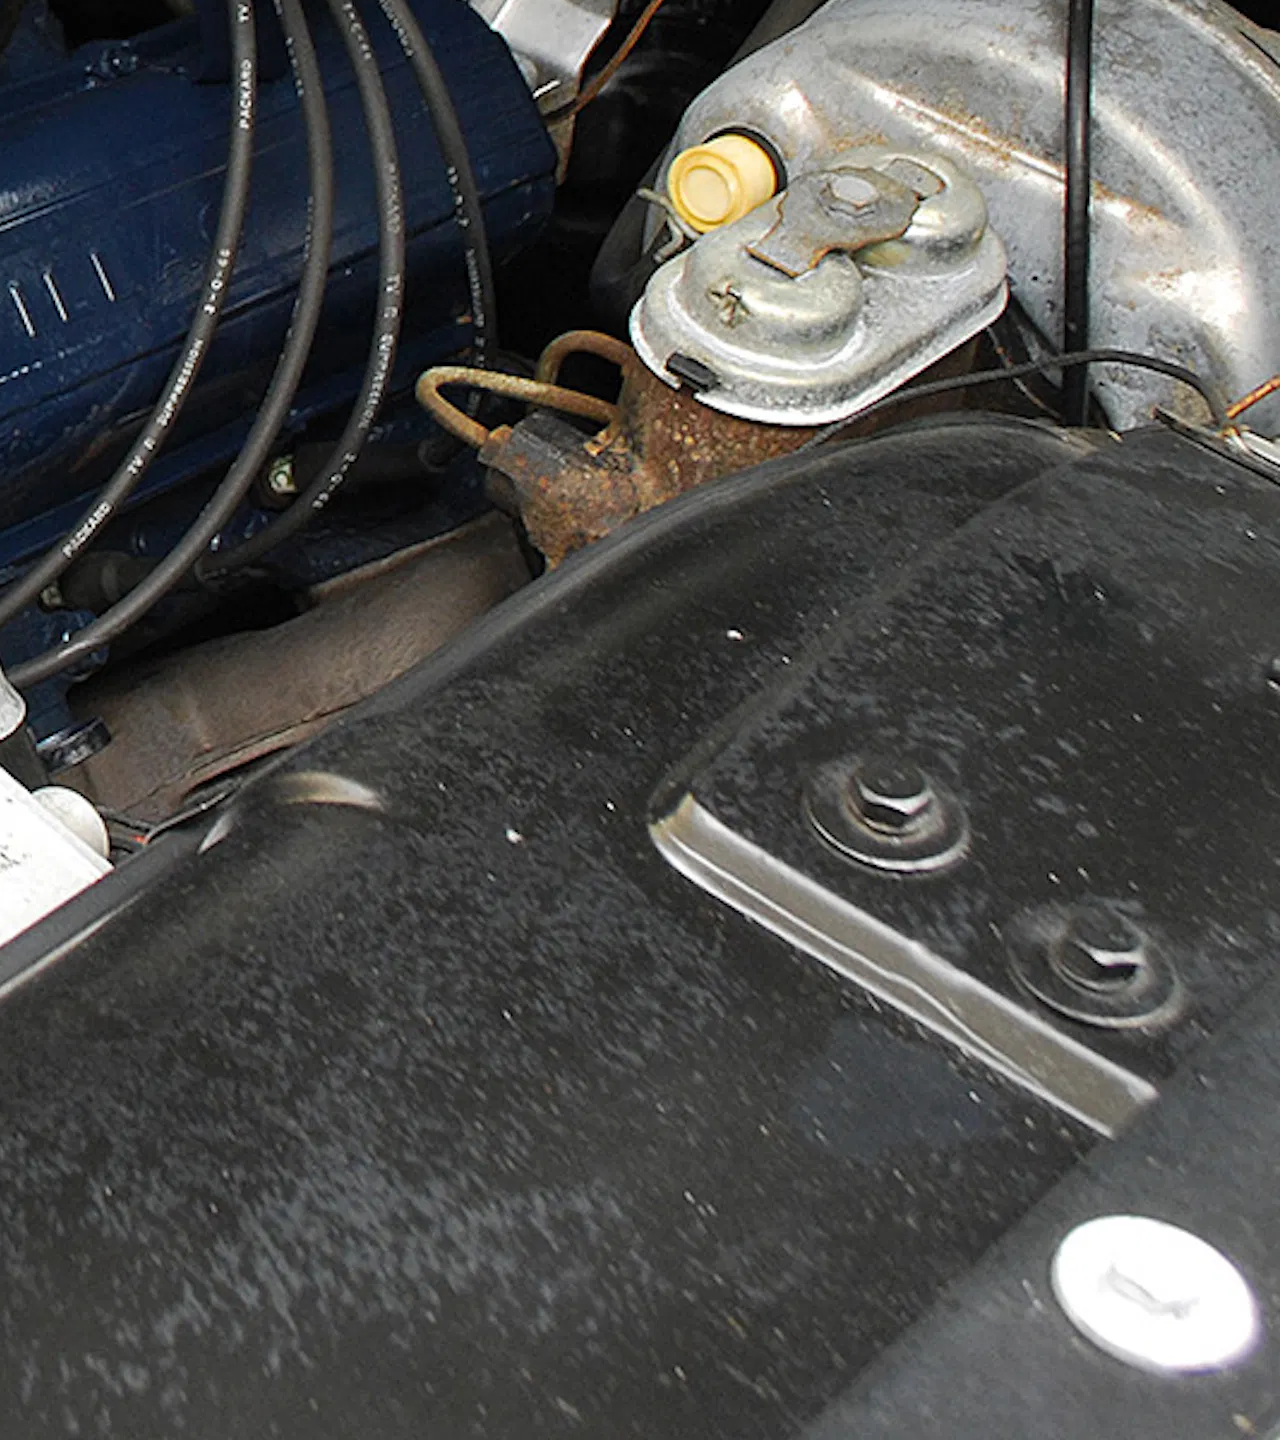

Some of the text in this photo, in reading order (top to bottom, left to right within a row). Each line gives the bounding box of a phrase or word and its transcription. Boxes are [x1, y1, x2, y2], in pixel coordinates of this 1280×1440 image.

[239, 59, 253, 131] PACKARD
[61, 500, 113, 558] PACKARD
[156, 338, 204, 427] SUPPRESSION
